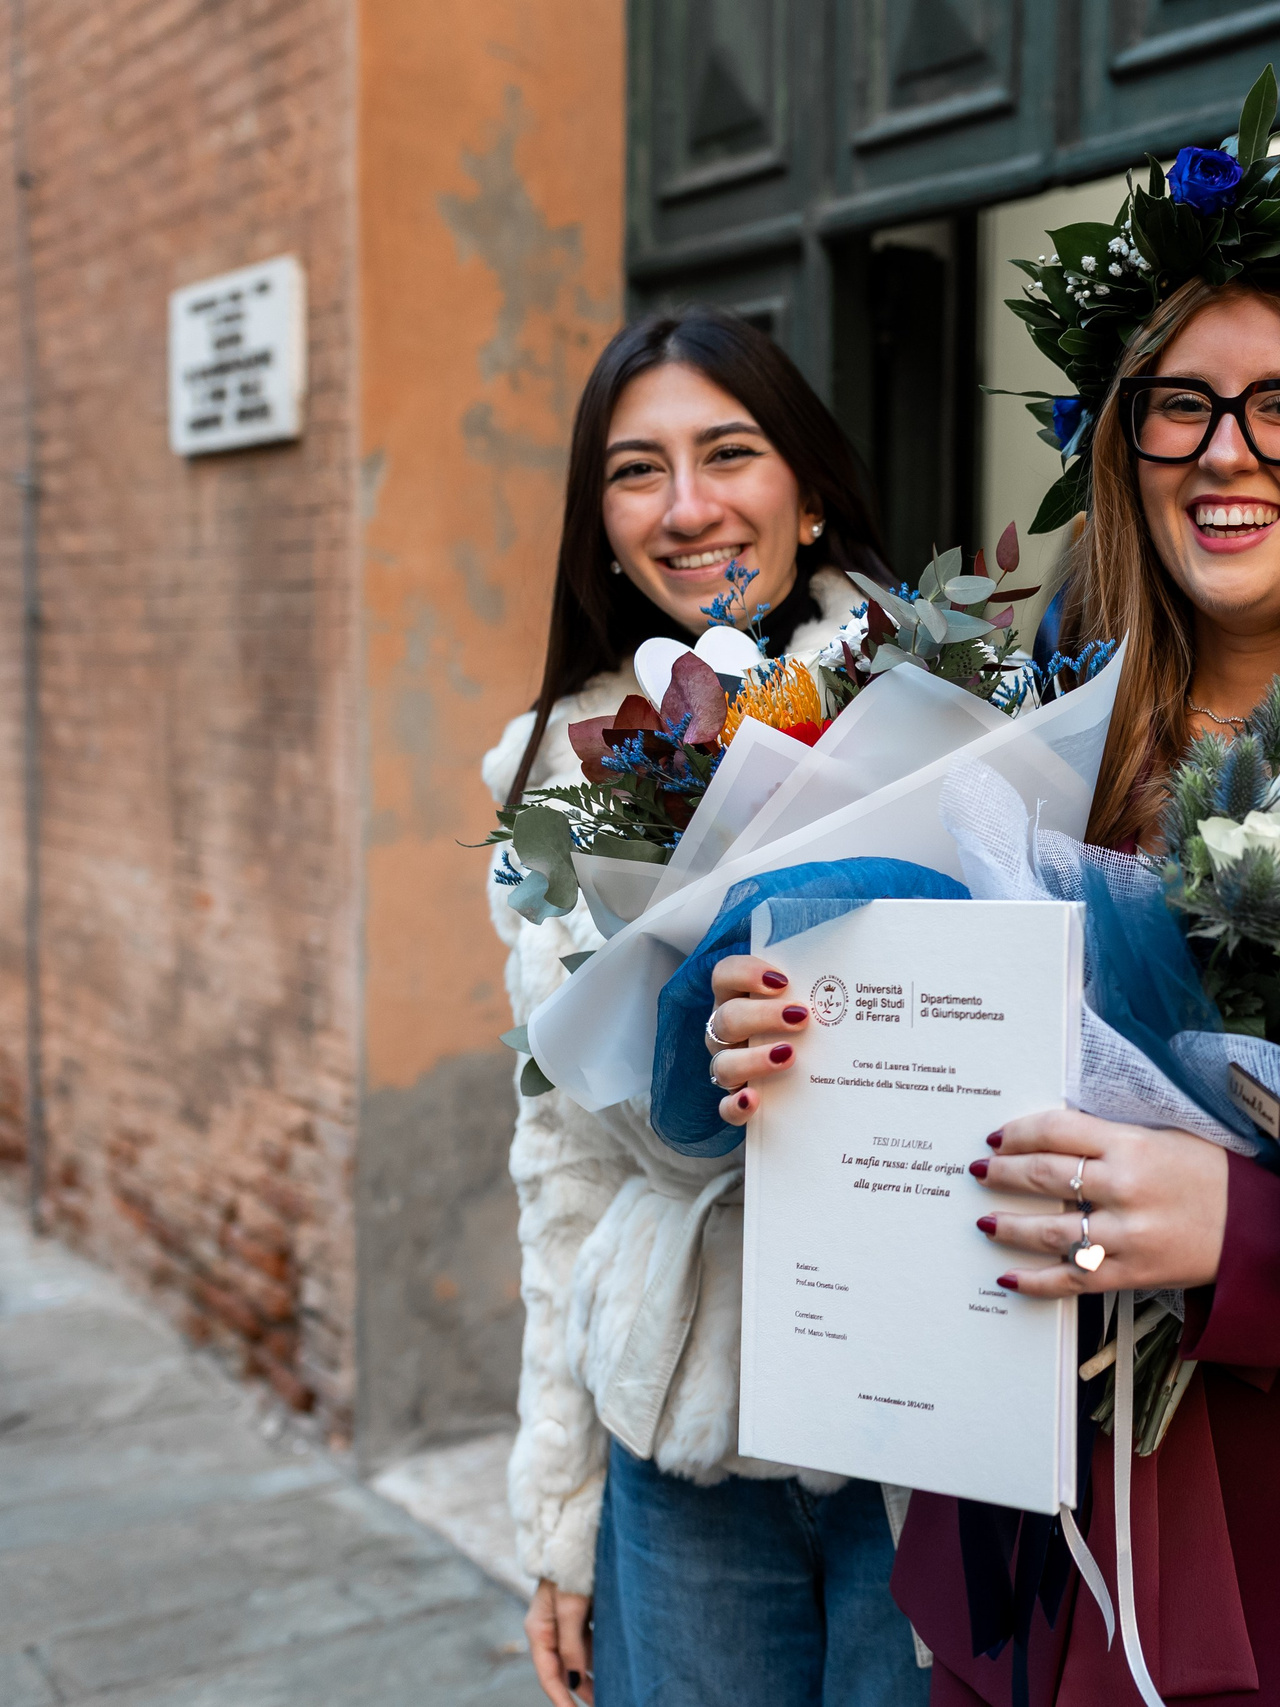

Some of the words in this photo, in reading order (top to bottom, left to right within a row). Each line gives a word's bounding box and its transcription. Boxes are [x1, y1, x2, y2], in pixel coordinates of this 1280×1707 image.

[855, 983, 903, 995] Università
[855, 997, 878, 1009] degli
[880, 998, 905, 1009] Studi
[920, 993, 983, 1007] Dipartimento
[855, 1012, 864, 1021] di
[866, 1012, 900, 1023] Ferrara
[920, 1007, 929, 1018] di
[931, 1007, 1005, 1021] Giurisprudenza
[853, 1060, 874, 1070] Corso
[875, 1061, 883, 1070] di
[884, 1061, 910, 1071] Laurea
[911, 1063, 947, 1074] Triennale
[949, 1066, 956, 1074] in
[810, 1075, 835, 1085] Scienze
[837, 1076, 874, 1088] Giuridiche
[876, 1079, 893, 1089] della
[895, 1080, 929, 1091] Sicurezza
[937, 1083, 954, 1093] della
[956, 1085, 1001, 1096] Prevenzione
[872, 1136, 890, 1146] TESI
[890, 1138, 900, 1148] DI
[901, 1139, 933, 1150] LAUREA
[841, 1153, 853, 1165] La
[855, 1156, 880, 1168] mafia
[881, 1159, 909, 1170] russa:
[911, 1160, 932, 1172] dalle
[934, 1163, 965, 1176] origini
[853, 1178, 870, 1189] alla
[871, 1181, 901, 1193] guerra
[903, 1183, 912, 1194] in
[914, 1184, 950, 1197] Ucraina
[873, 1395, 906, 1406] Accademico
